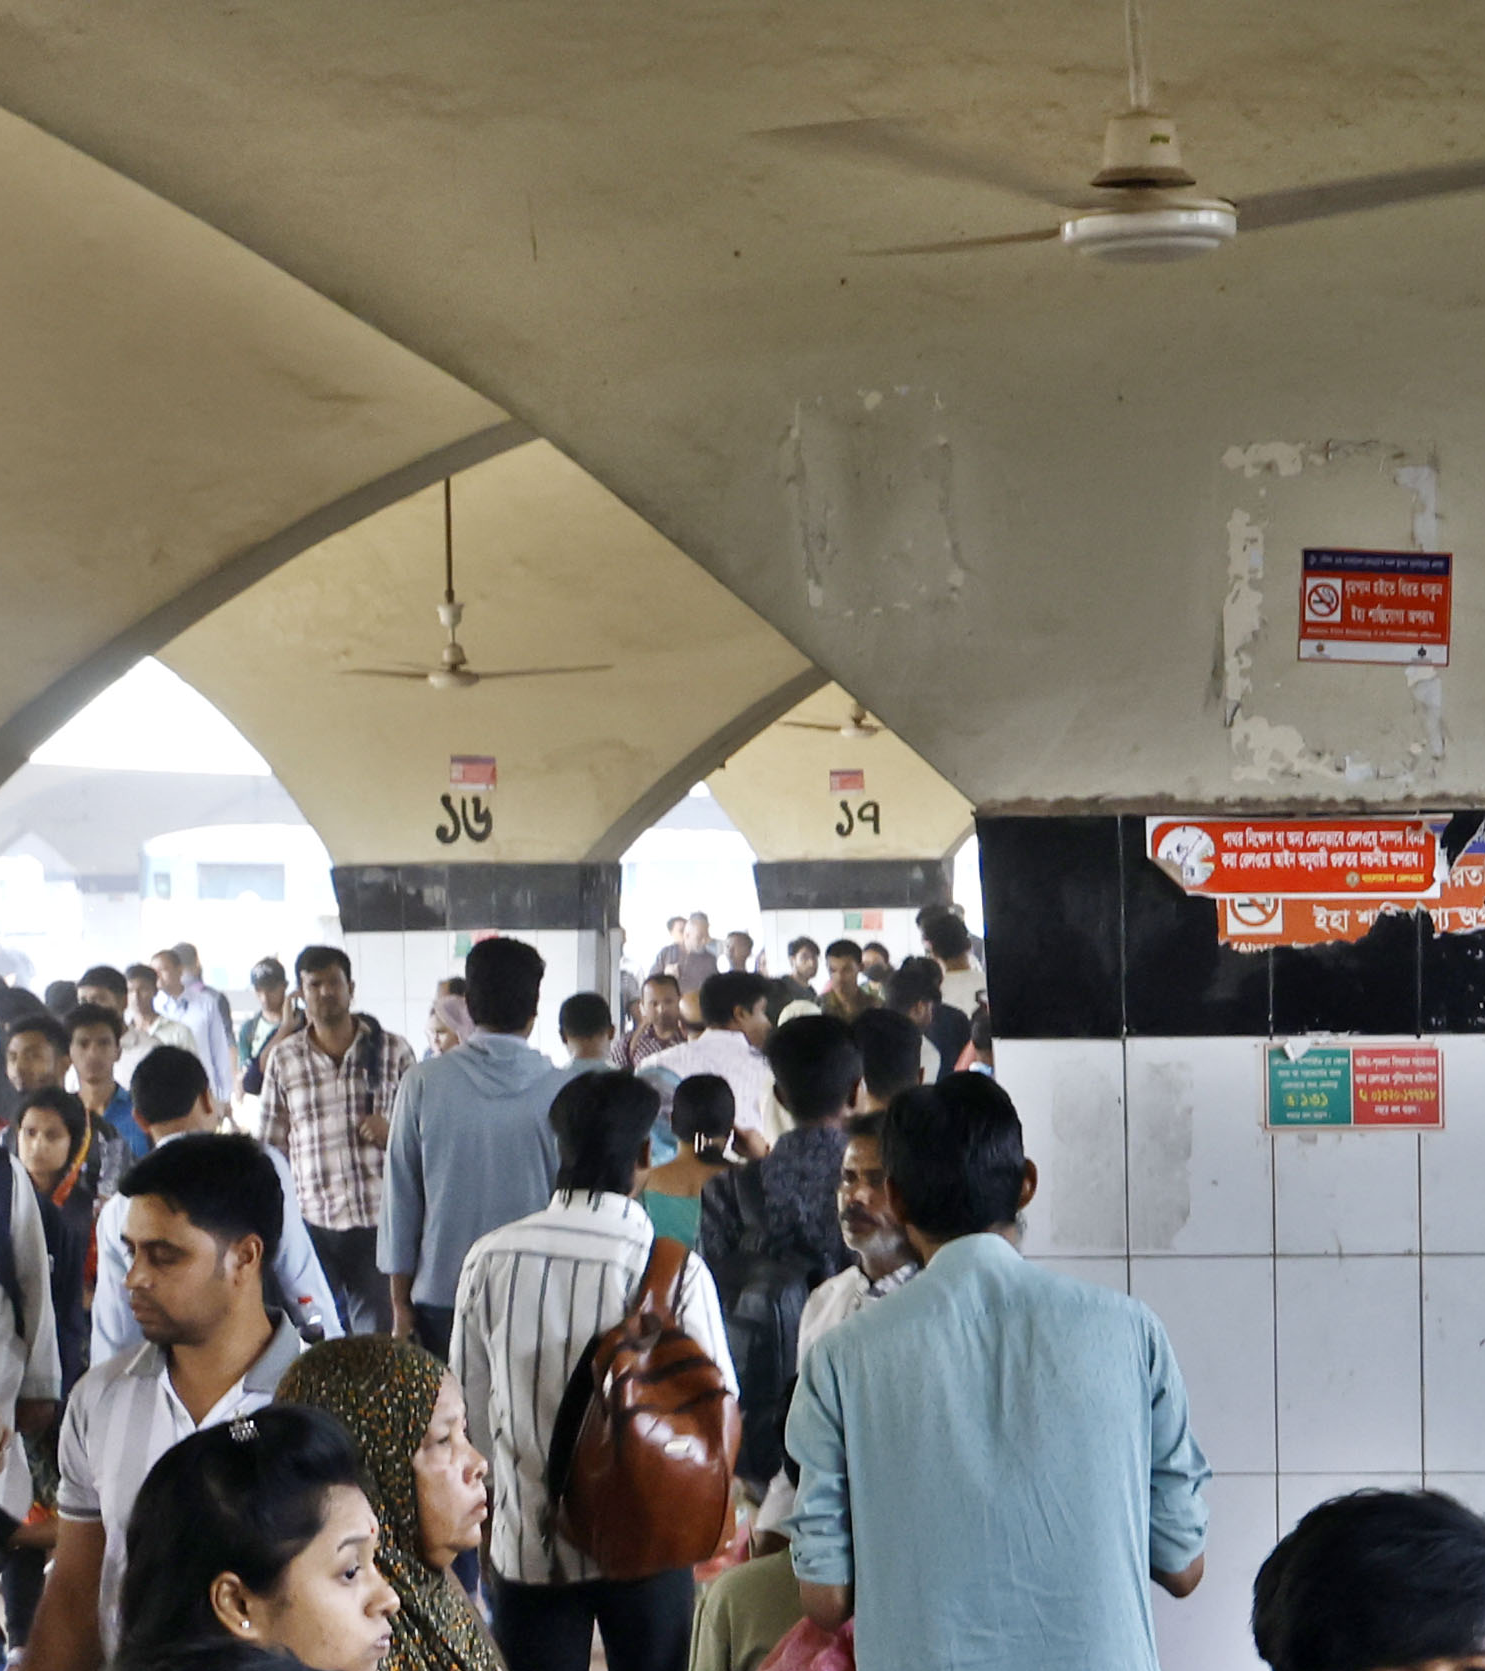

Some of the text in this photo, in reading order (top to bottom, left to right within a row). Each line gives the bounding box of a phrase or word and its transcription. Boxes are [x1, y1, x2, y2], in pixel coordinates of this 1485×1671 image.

[435, 793, 493, 844] ১৬
[835, 800, 881, 838] ১৭
[1313, 904, 1350, 934] ইহা
